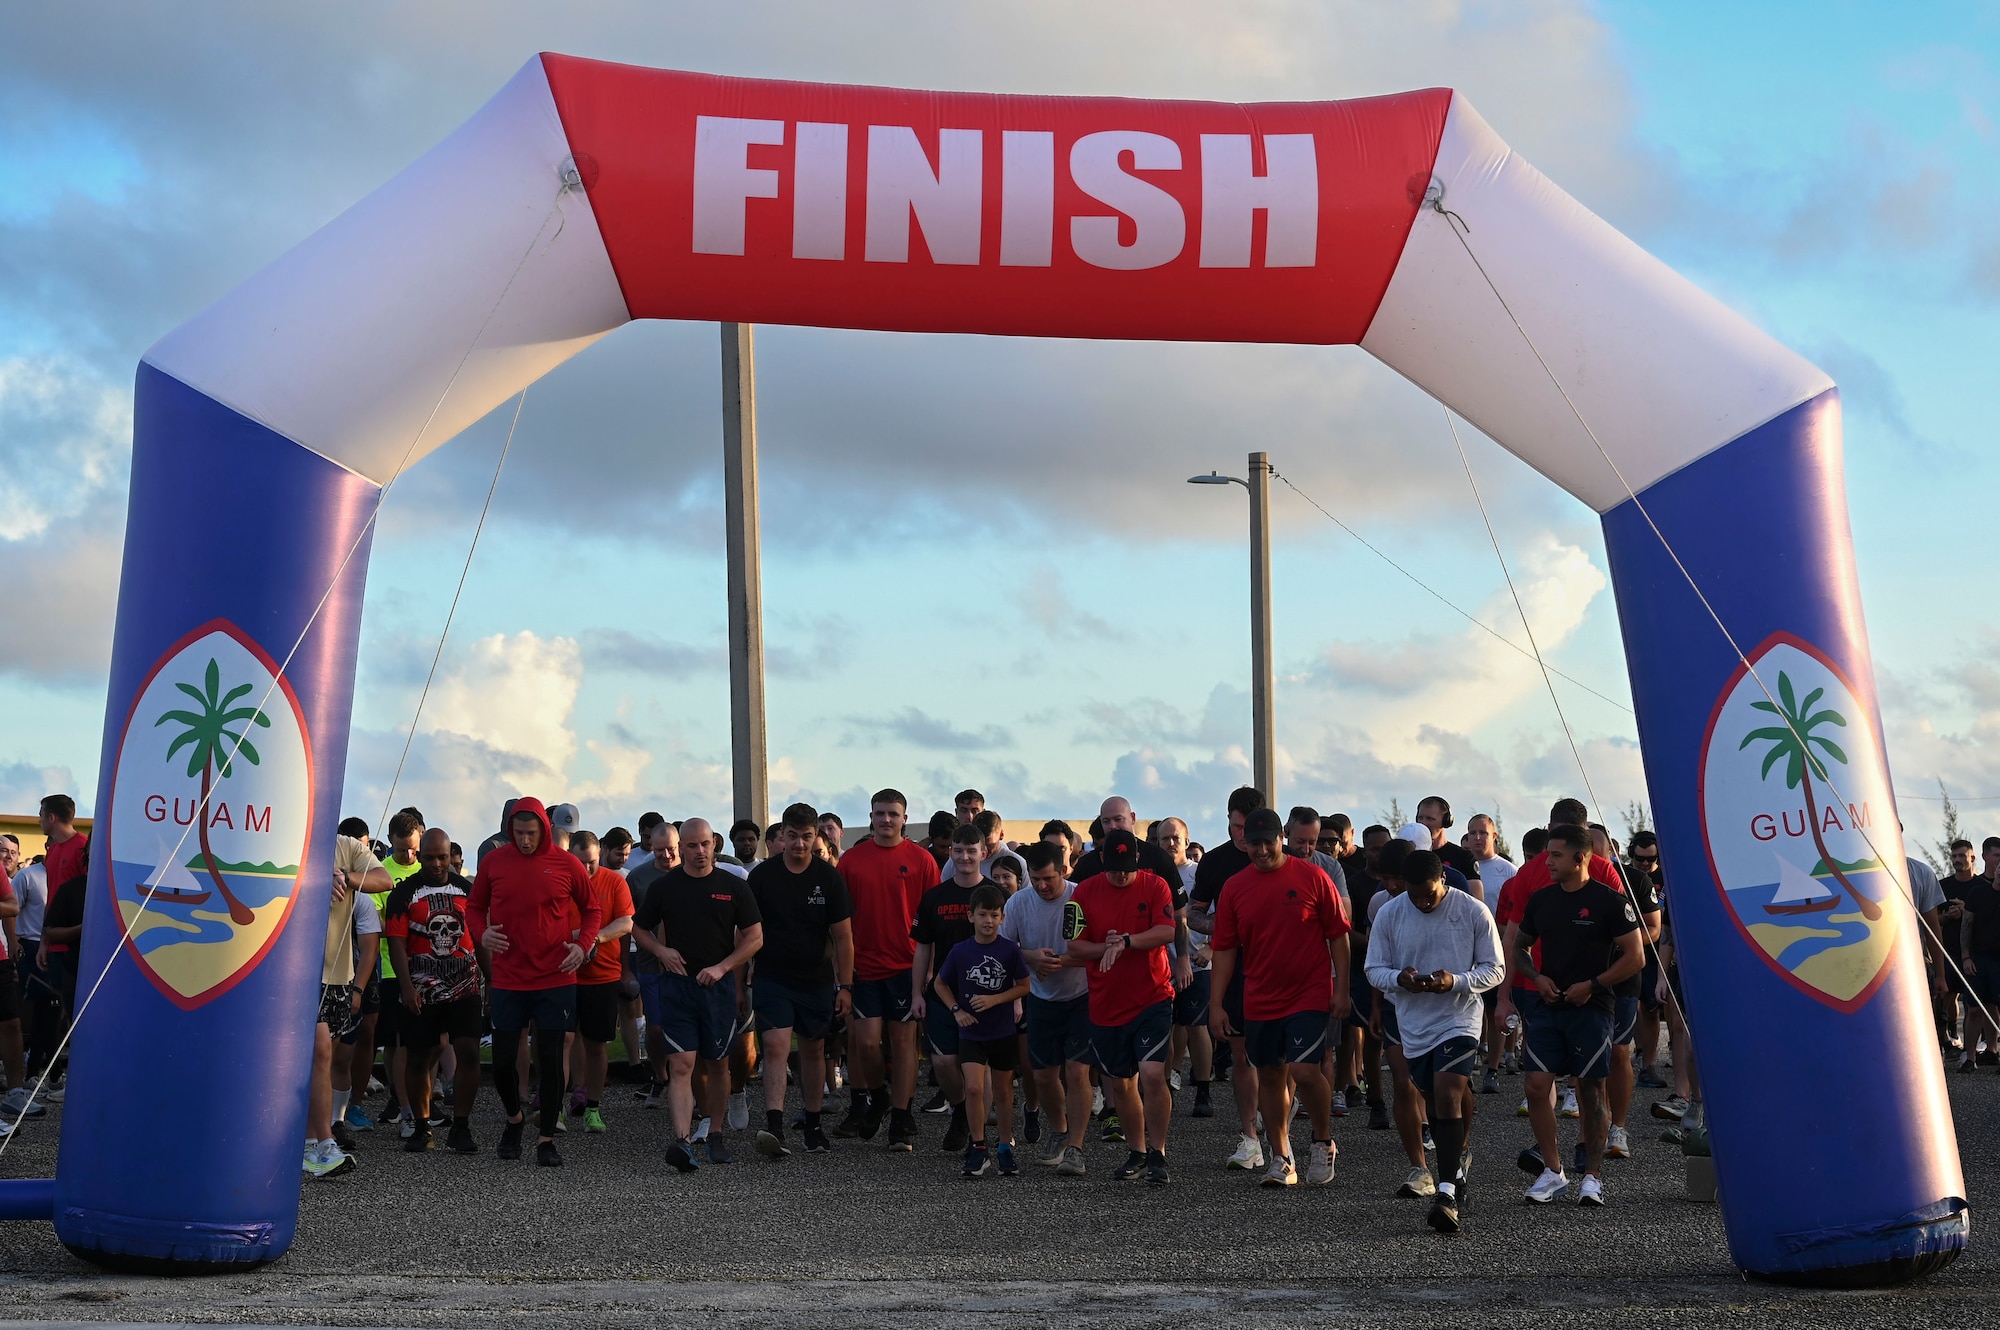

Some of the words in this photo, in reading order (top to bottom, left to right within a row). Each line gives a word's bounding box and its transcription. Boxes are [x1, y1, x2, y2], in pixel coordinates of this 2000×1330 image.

[692, 115, 1319, 271] FINISH
[144, 794, 272, 833] GUAM
[1750, 801, 1872, 841] GUAM
[969, 968, 1002, 989] ACU
